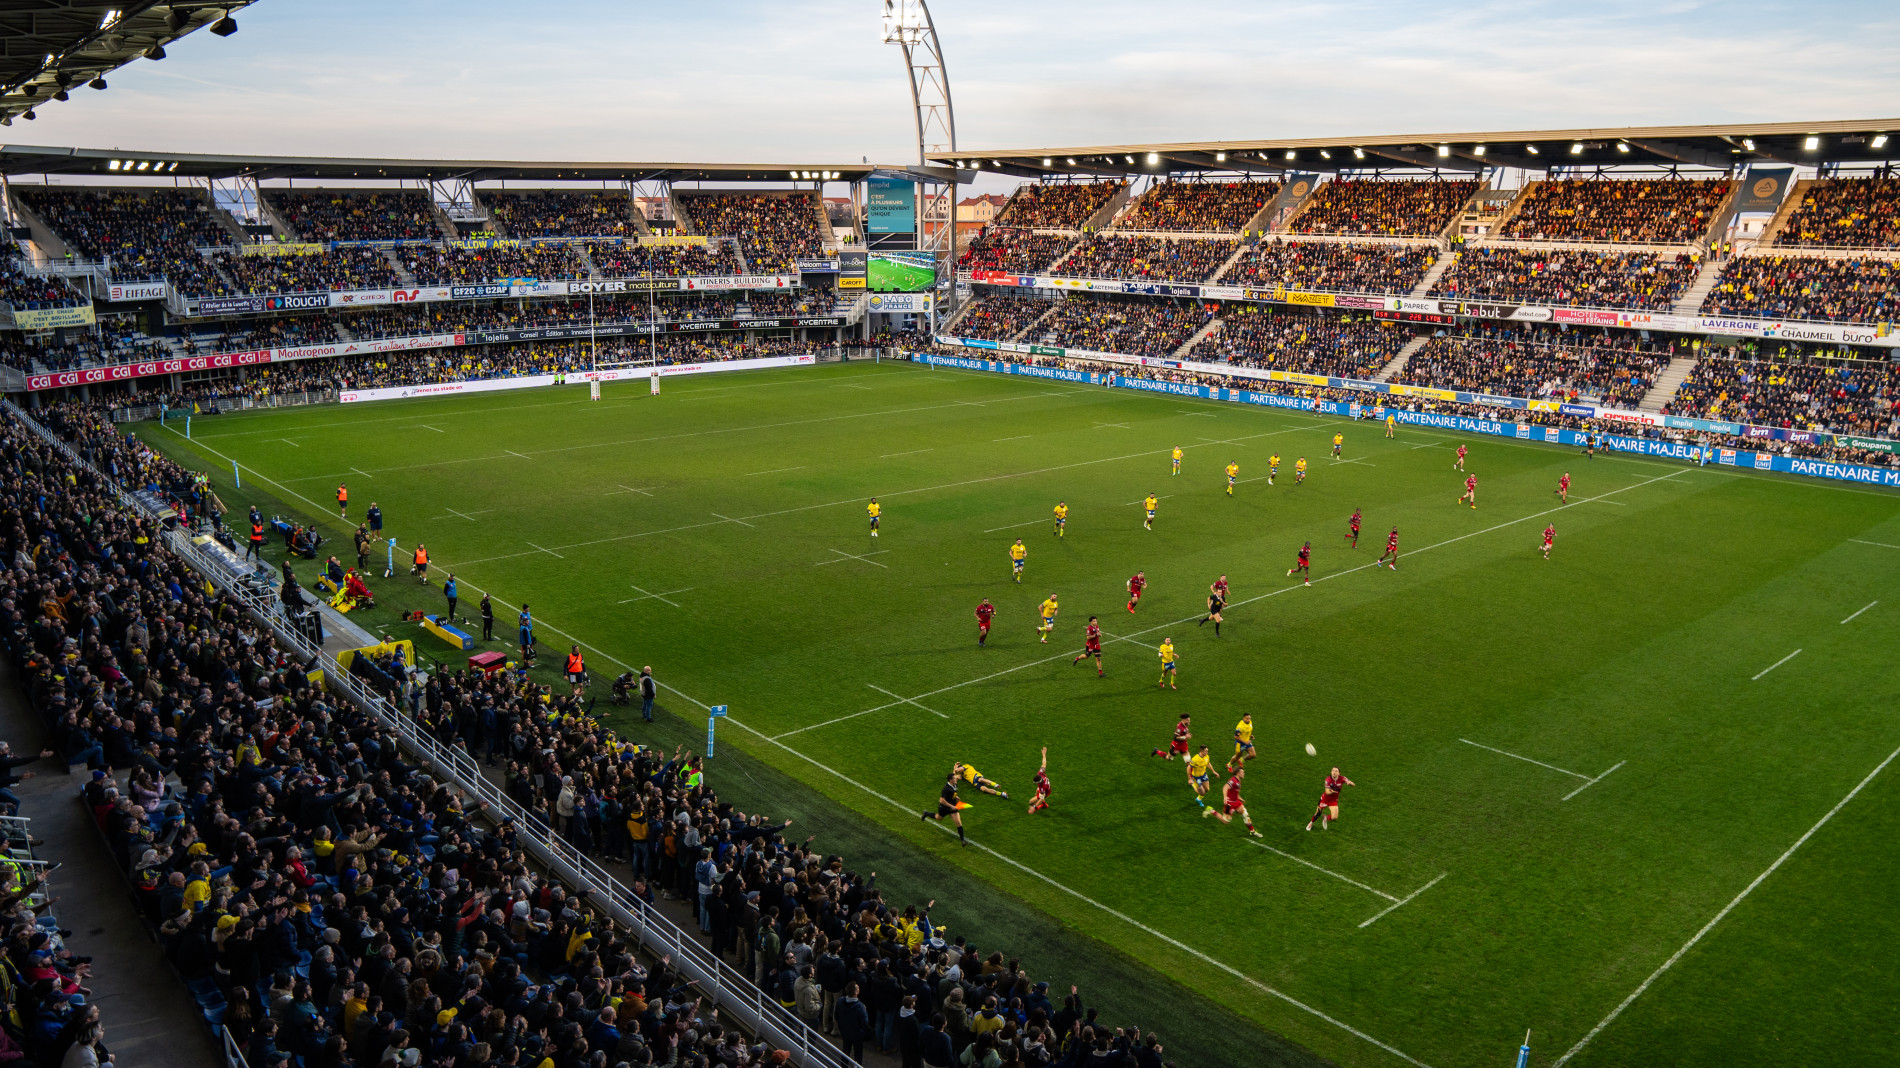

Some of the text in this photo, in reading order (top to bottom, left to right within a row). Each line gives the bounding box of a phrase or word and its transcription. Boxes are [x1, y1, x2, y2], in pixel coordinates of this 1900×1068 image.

[242, 245, 279, 254] INTERCLUBS
[450, 240, 520, 249] YELLOW ARMY
[485, 286, 508, 294] C2AP
[570, 282, 627, 292] BOYER
[629, 281, 678, 289] motoculture
[1172, 288, 1191, 296] lojelis
[126, 287, 164, 298] EIFFAGE
[284, 296, 327, 308] ROUCHY
[884, 295, 912, 303] LABO
[1293, 293, 1329, 304] MAZET
[1404, 302, 1429, 310] PAPREC
[1464, 304, 1500, 318] babut
[48, 319, 85, 327] MONTFERRAND
[1586, 318, 1615, 326] ESTAING
[1632, 314, 1651, 323] JLM
[1702, 320, 1759, 330] LAVERGNE
[485, 334, 509, 342] lojelis
[1781, 330, 1835, 341] CHAUMEIL
[1843, 330, 1872, 343] buro
[278, 348, 335, 359] Montrognon
[959, 360, 982, 369] MAJEUR
[31, 376, 51, 388] CGI
[59, 373, 78, 384] CGI
[86, 370, 105, 381] CGI
[112, 367, 131, 378] CGI
[138, 364, 156, 374] CGI
[163, 361, 182, 372] CGI
[189, 358, 207, 368] CGI
[214, 356, 232, 366] CGI
[239, 353, 256, 364] CGI
[1018, 366, 1082, 381] PARTENAIRE MAJEUR
[1125, 379, 1199, 395] PARTENAIRE MAJEUR
[1250, 394, 1337, 413] PARTENAIRE MAEUR
[1397, 412, 1502, 433] PARTENAIRE MAJEUR
[1574, 433, 1644, 453] PATNAIRE
[1852, 440, 1892, 450] Groupama
[1756, 460, 1770, 468] GMF
[1791, 460, 1900, 484] PARTENAIRE M
